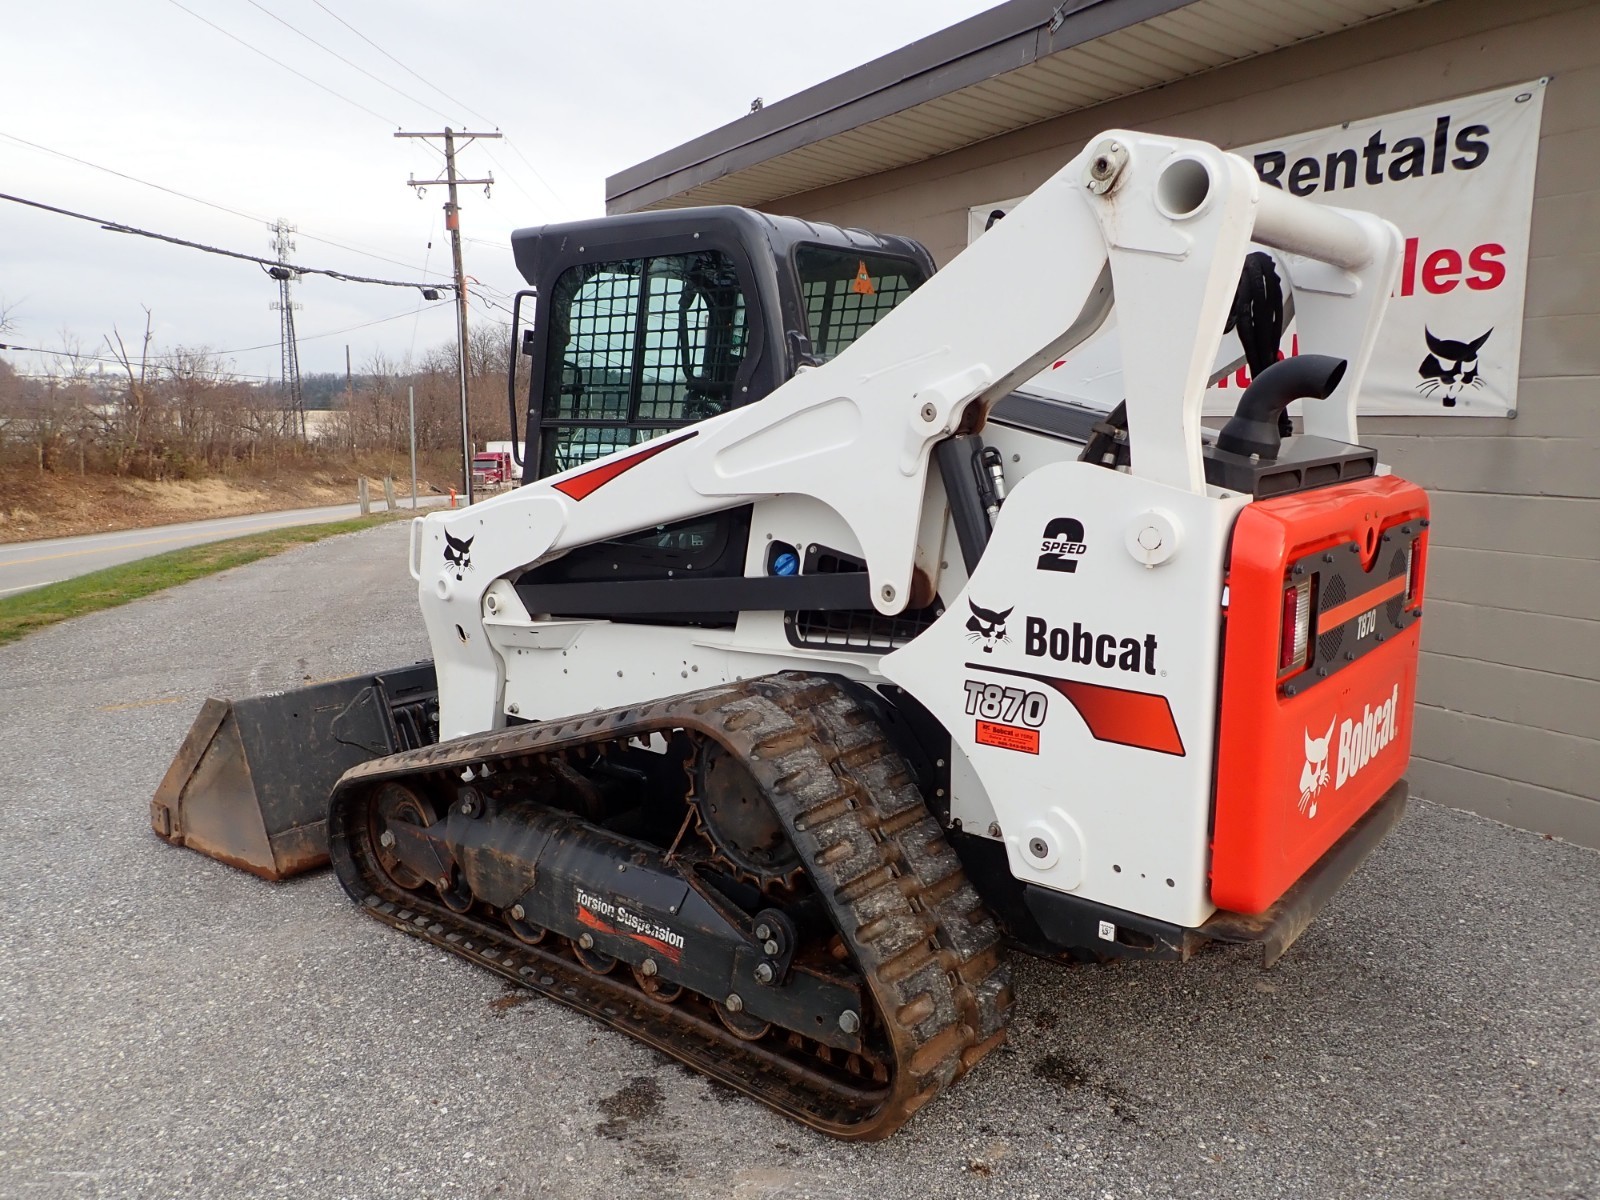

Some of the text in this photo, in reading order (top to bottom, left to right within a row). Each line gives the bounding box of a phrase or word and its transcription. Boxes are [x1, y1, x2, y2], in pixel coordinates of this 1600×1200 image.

[1253, 115, 1490, 198] Rentals
[1036, 517, 1085, 573] 2
[1040, 541, 1087, 555] SPEED
[1025, 616, 1157, 675] Bobcat
[1357, 608, 1376, 640] T870
[964, 680, 1048, 727] T870
[1335, 683, 1398, 790] Bobcat
[576, 887, 685, 949] Torsion Suspension
